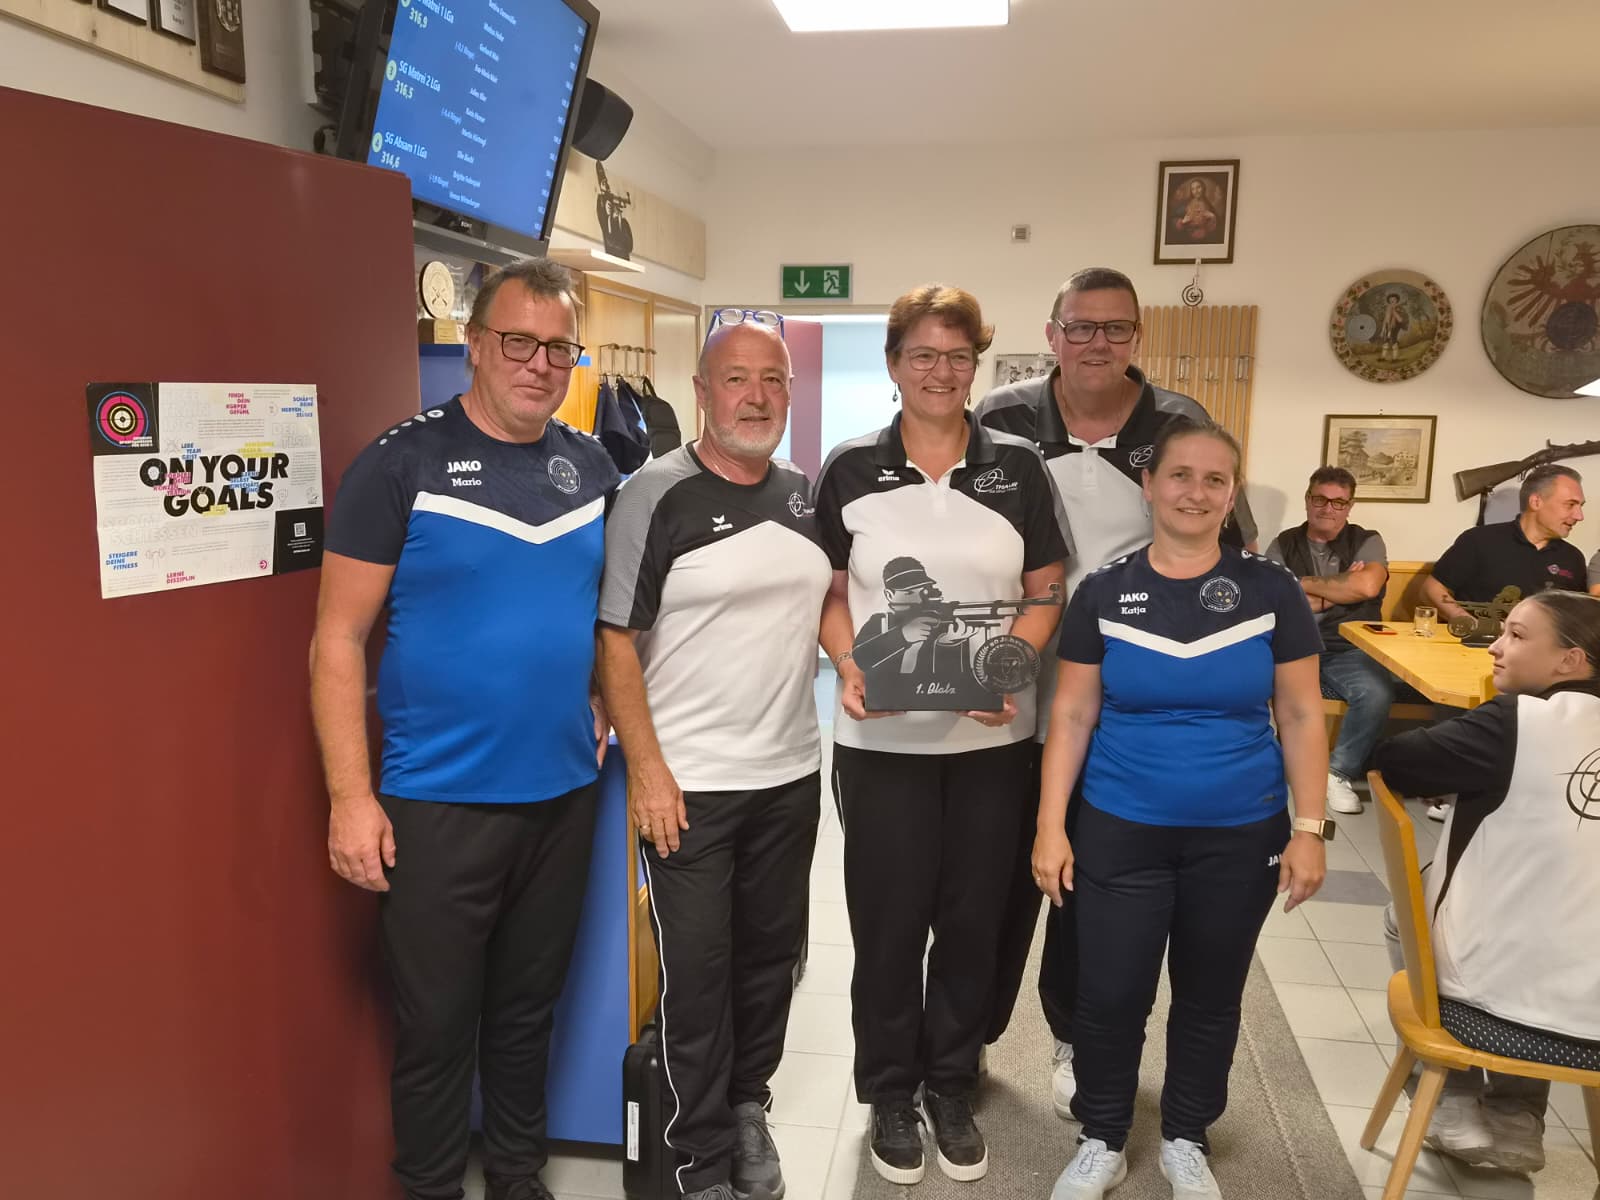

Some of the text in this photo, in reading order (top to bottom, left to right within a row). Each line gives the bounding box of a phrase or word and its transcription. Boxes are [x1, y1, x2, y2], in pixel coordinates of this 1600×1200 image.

[409, 7, 428, 29] 316,9
[399, 60, 408, 74] SG
[394, 80, 414, 99] 316,5
[384, 131, 394, 145] SG
[380, 150, 400, 169] 314,6
[139, 457, 194, 488] ON
[199, 453, 290, 483] YOUR
[447, 460, 482, 473] JAKO
[451, 477, 482, 487] Mario
[163, 482, 274, 518] GOALS
[112, 562, 138, 570] FITNESS
[1118, 592, 1149, 603] JAKO
[1121, 606, 1147, 615] Katja
[915, 682, 924, 694] 1.
